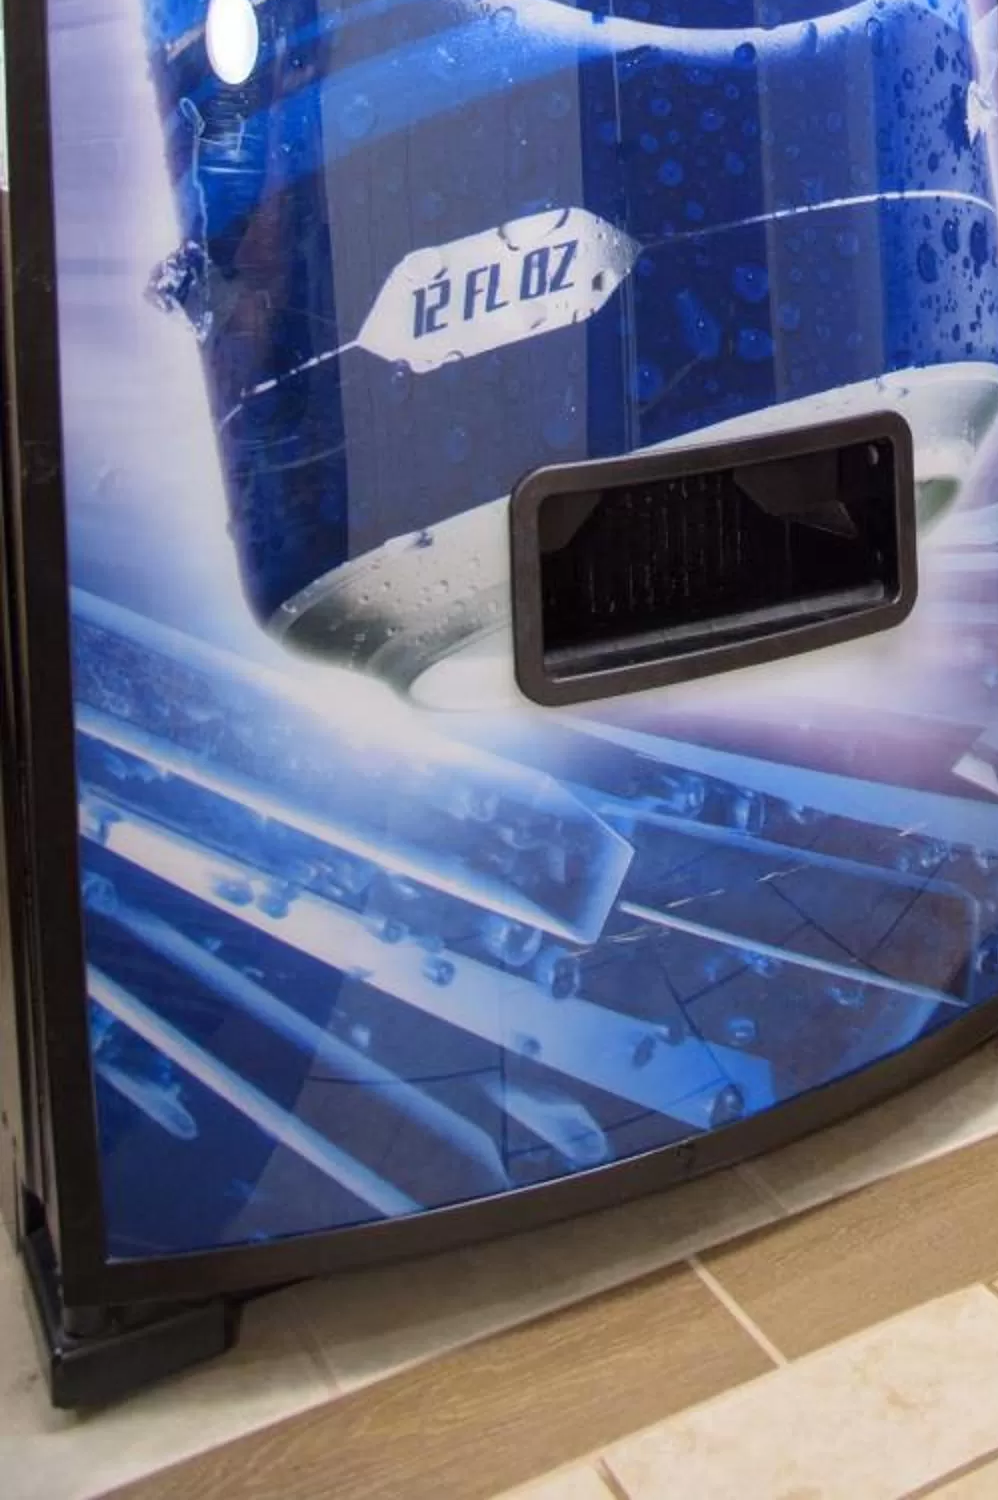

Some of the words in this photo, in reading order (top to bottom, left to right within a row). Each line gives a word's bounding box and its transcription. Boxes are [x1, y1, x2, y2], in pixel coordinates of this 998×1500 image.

[411, 278, 450, 339] 12
[463, 263, 509, 321] FL
[519, 239, 578, 301] OZ
